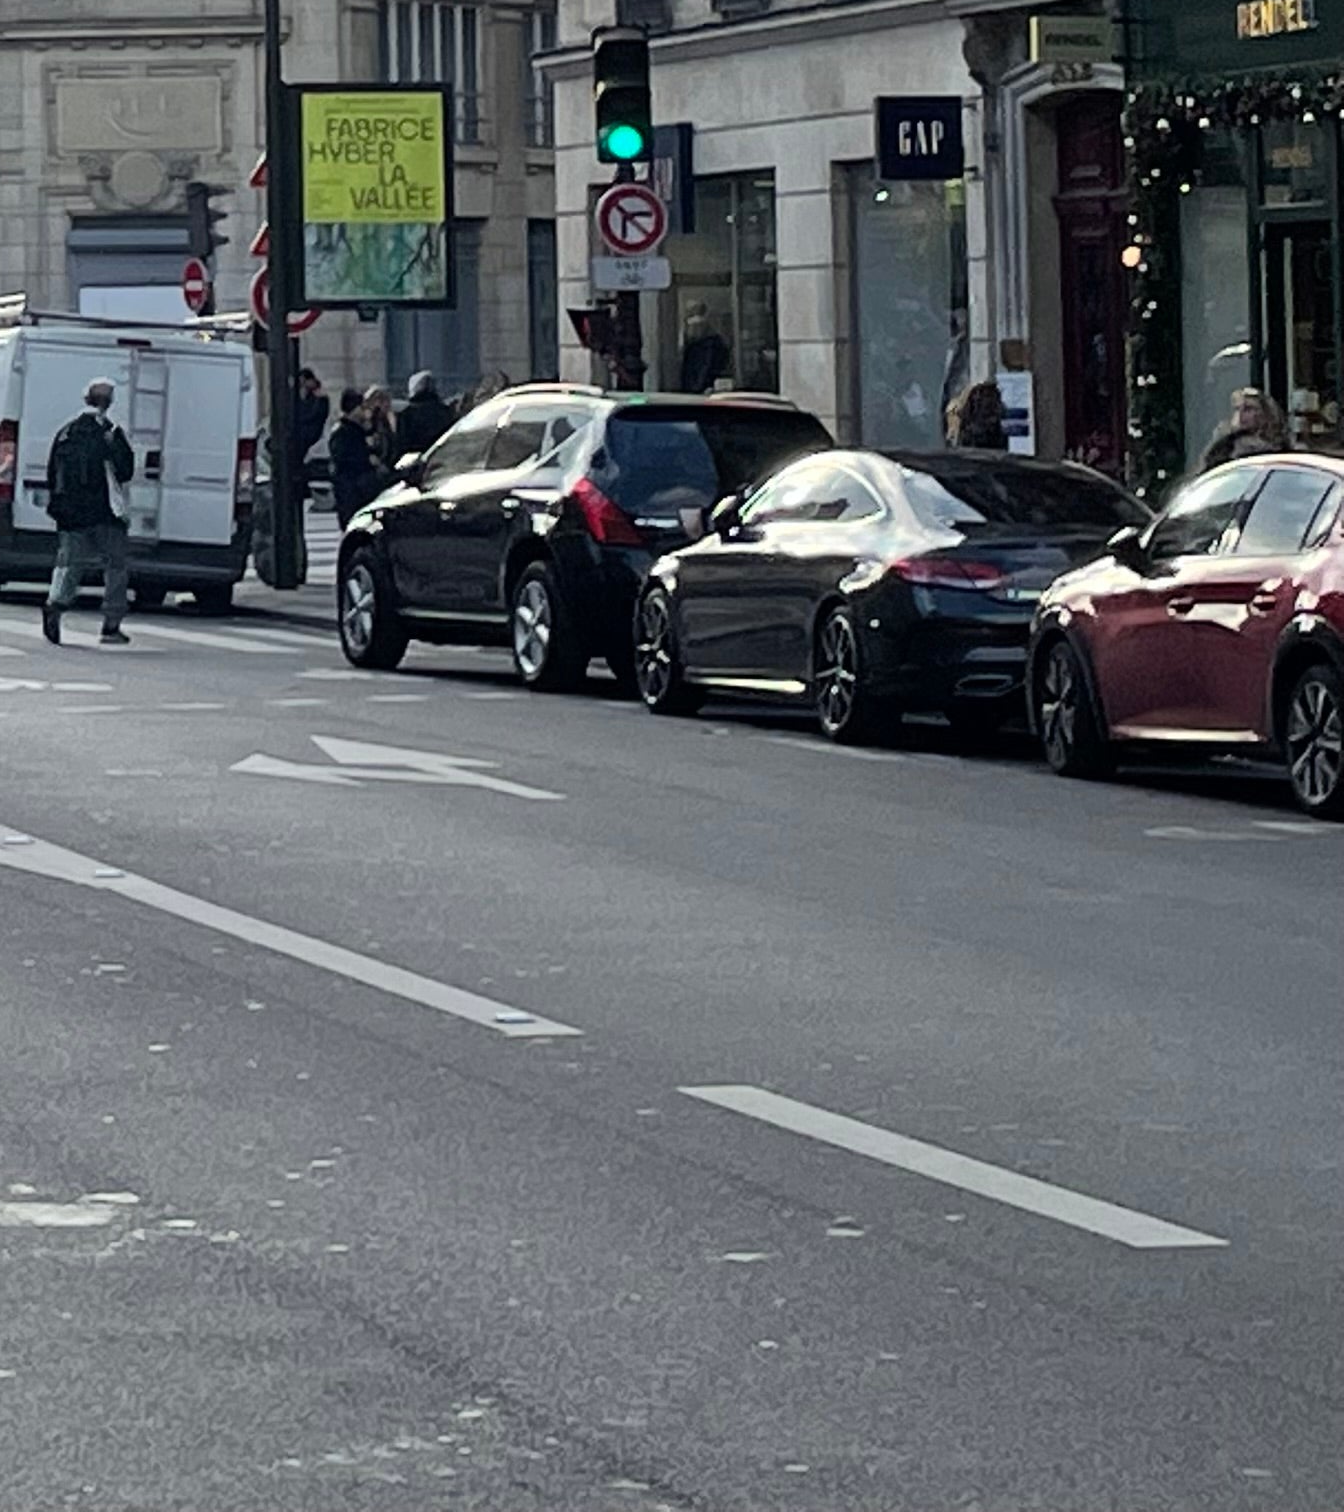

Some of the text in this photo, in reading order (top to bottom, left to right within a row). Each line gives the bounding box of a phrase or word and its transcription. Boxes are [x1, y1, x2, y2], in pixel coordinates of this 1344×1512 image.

[326, 117, 435, 141] FABRICE
[899, 120, 944, 156] GAP
[308, 140, 395, 165] HYBER
[379, 164, 409, 188] LA
